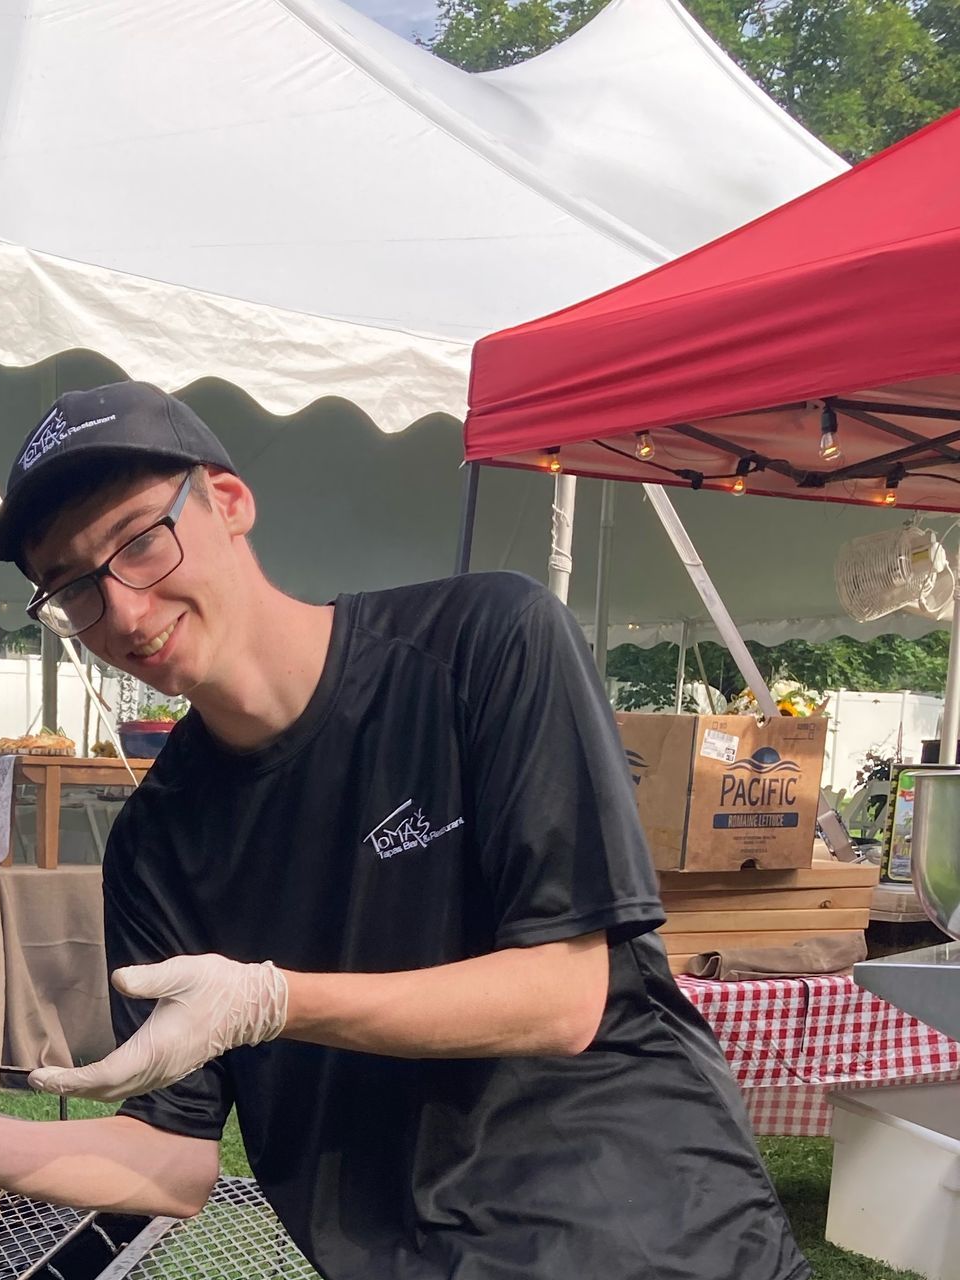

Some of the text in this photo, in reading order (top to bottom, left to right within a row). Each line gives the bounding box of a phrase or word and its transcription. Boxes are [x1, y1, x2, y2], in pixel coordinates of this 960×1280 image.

[67, 414, 116, 436] Restaurant
[720, 774, 797, 806] PACIFIC
[728, 814, 784, 827] ROMAINE LETTUCE
[377, 845, 403, 859] Tapas
[403, 839, 418, 851] Bar
